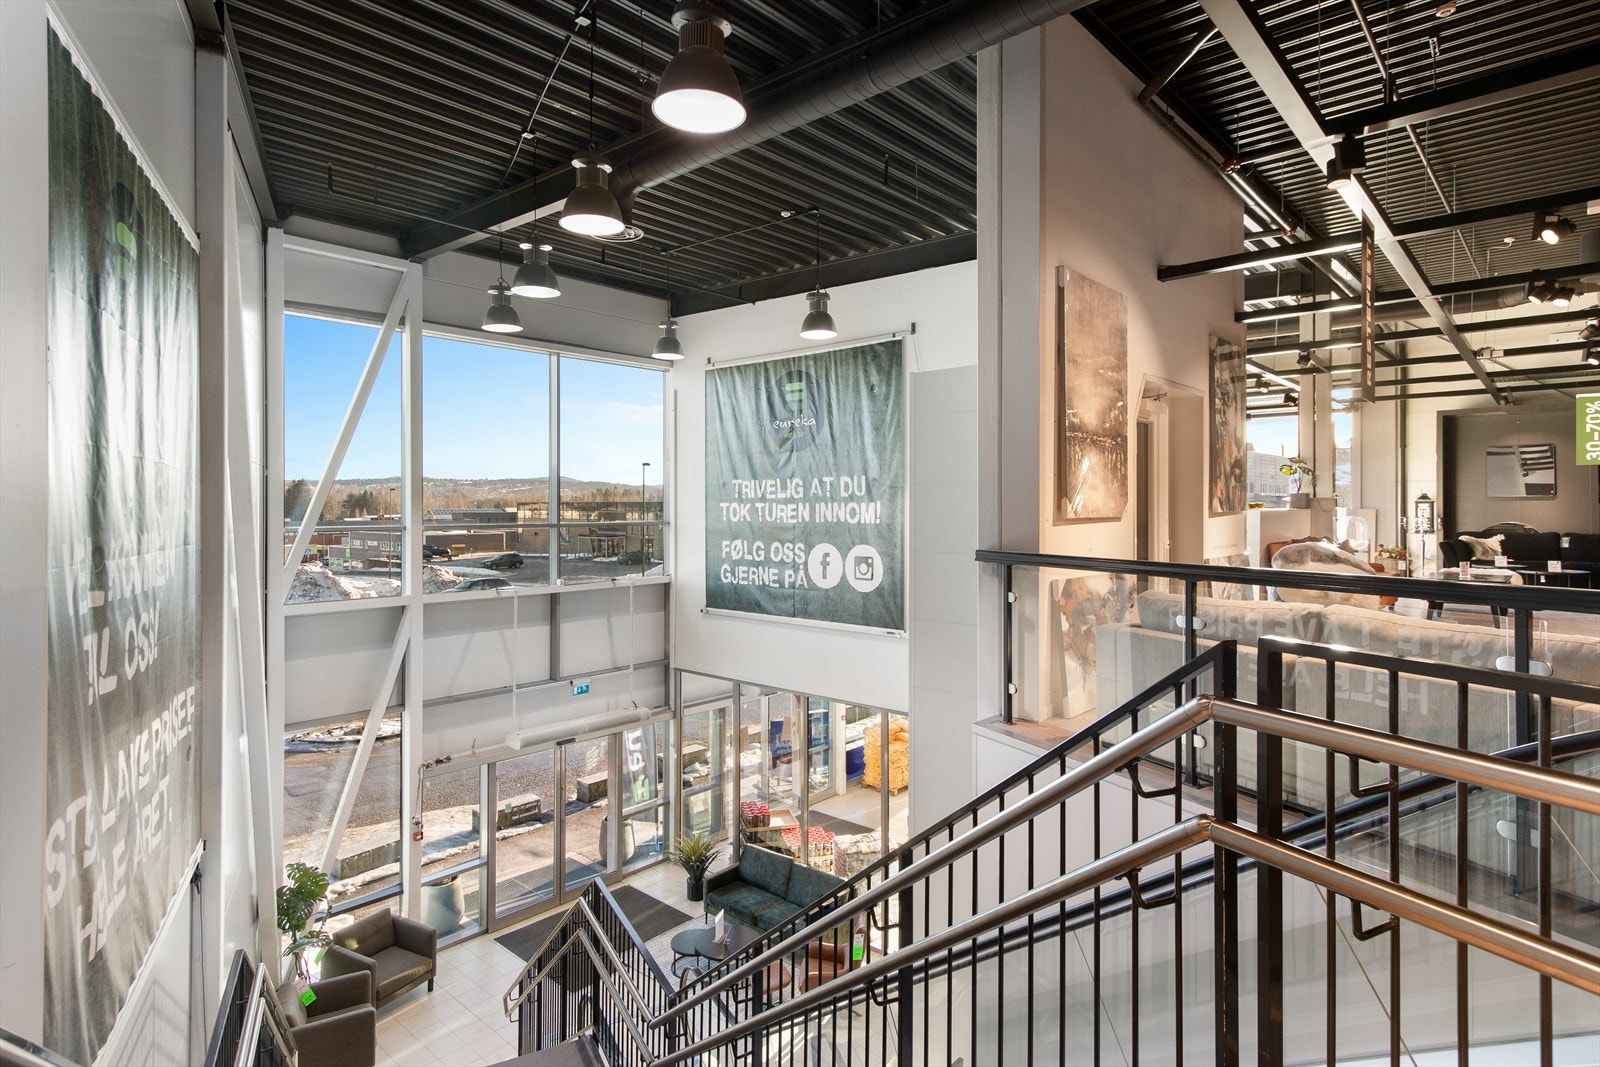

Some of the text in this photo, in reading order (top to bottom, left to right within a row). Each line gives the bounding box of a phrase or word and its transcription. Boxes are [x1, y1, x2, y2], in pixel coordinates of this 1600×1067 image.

[773, 414, 816, 429] eureka
[1585, 400, 1600, 461] 30-70%
[732, 475, 866, 499] TRIVELIG AT DU
[719, 501, 881, 524] TOK TUREN INNOM!
[721, 539, 806, 564] FØLG OSS
[720, 564, 809, 589] GJERNE PÅ
[124, 601, 161, 681] OSS!
